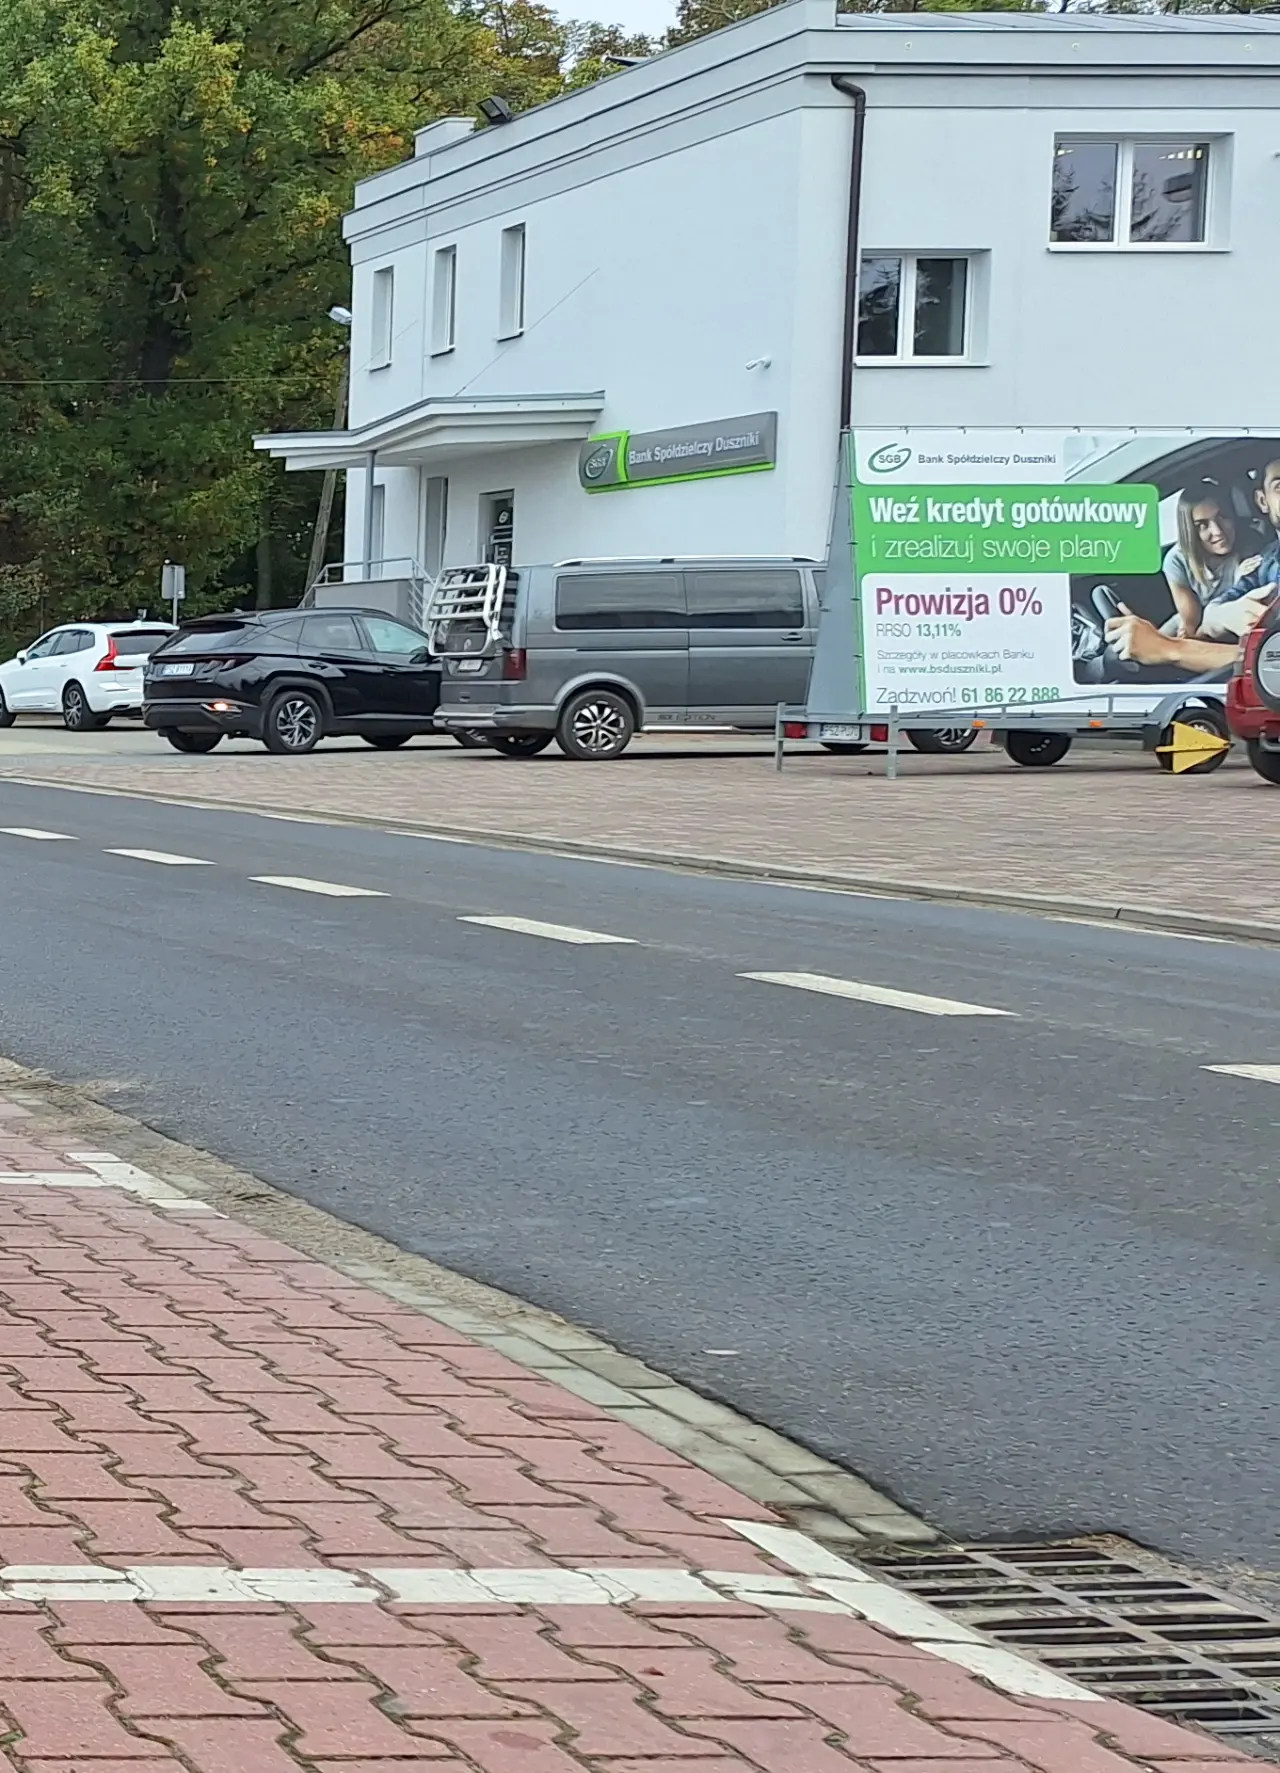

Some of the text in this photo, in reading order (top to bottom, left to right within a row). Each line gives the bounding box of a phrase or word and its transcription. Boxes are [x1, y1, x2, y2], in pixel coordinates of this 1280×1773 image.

[628, 431, 760, 465] Bank Spółdzielczy Duszniki
[878, 454, 901, 464] SGB
[918, 453, 1056, 465] Bank Spółdzielczy Duszniki
[869, 496, 1148, 529] Weź kredyt gotówkowy
[871, 535, 1121, 563] i zrealizuj swoje plany
[876, 587, 1043, 621] Prowizja 0%
[876, 623, 961, 639] RRSO 13,11%
[877, 650, 926, 662] Szczegóły
[1003, 649, 1035, 660] Banku
[883, 666, 896, 674] na
[876, 686, 1060, 704] Zadzwoń! 61 86 22 888
